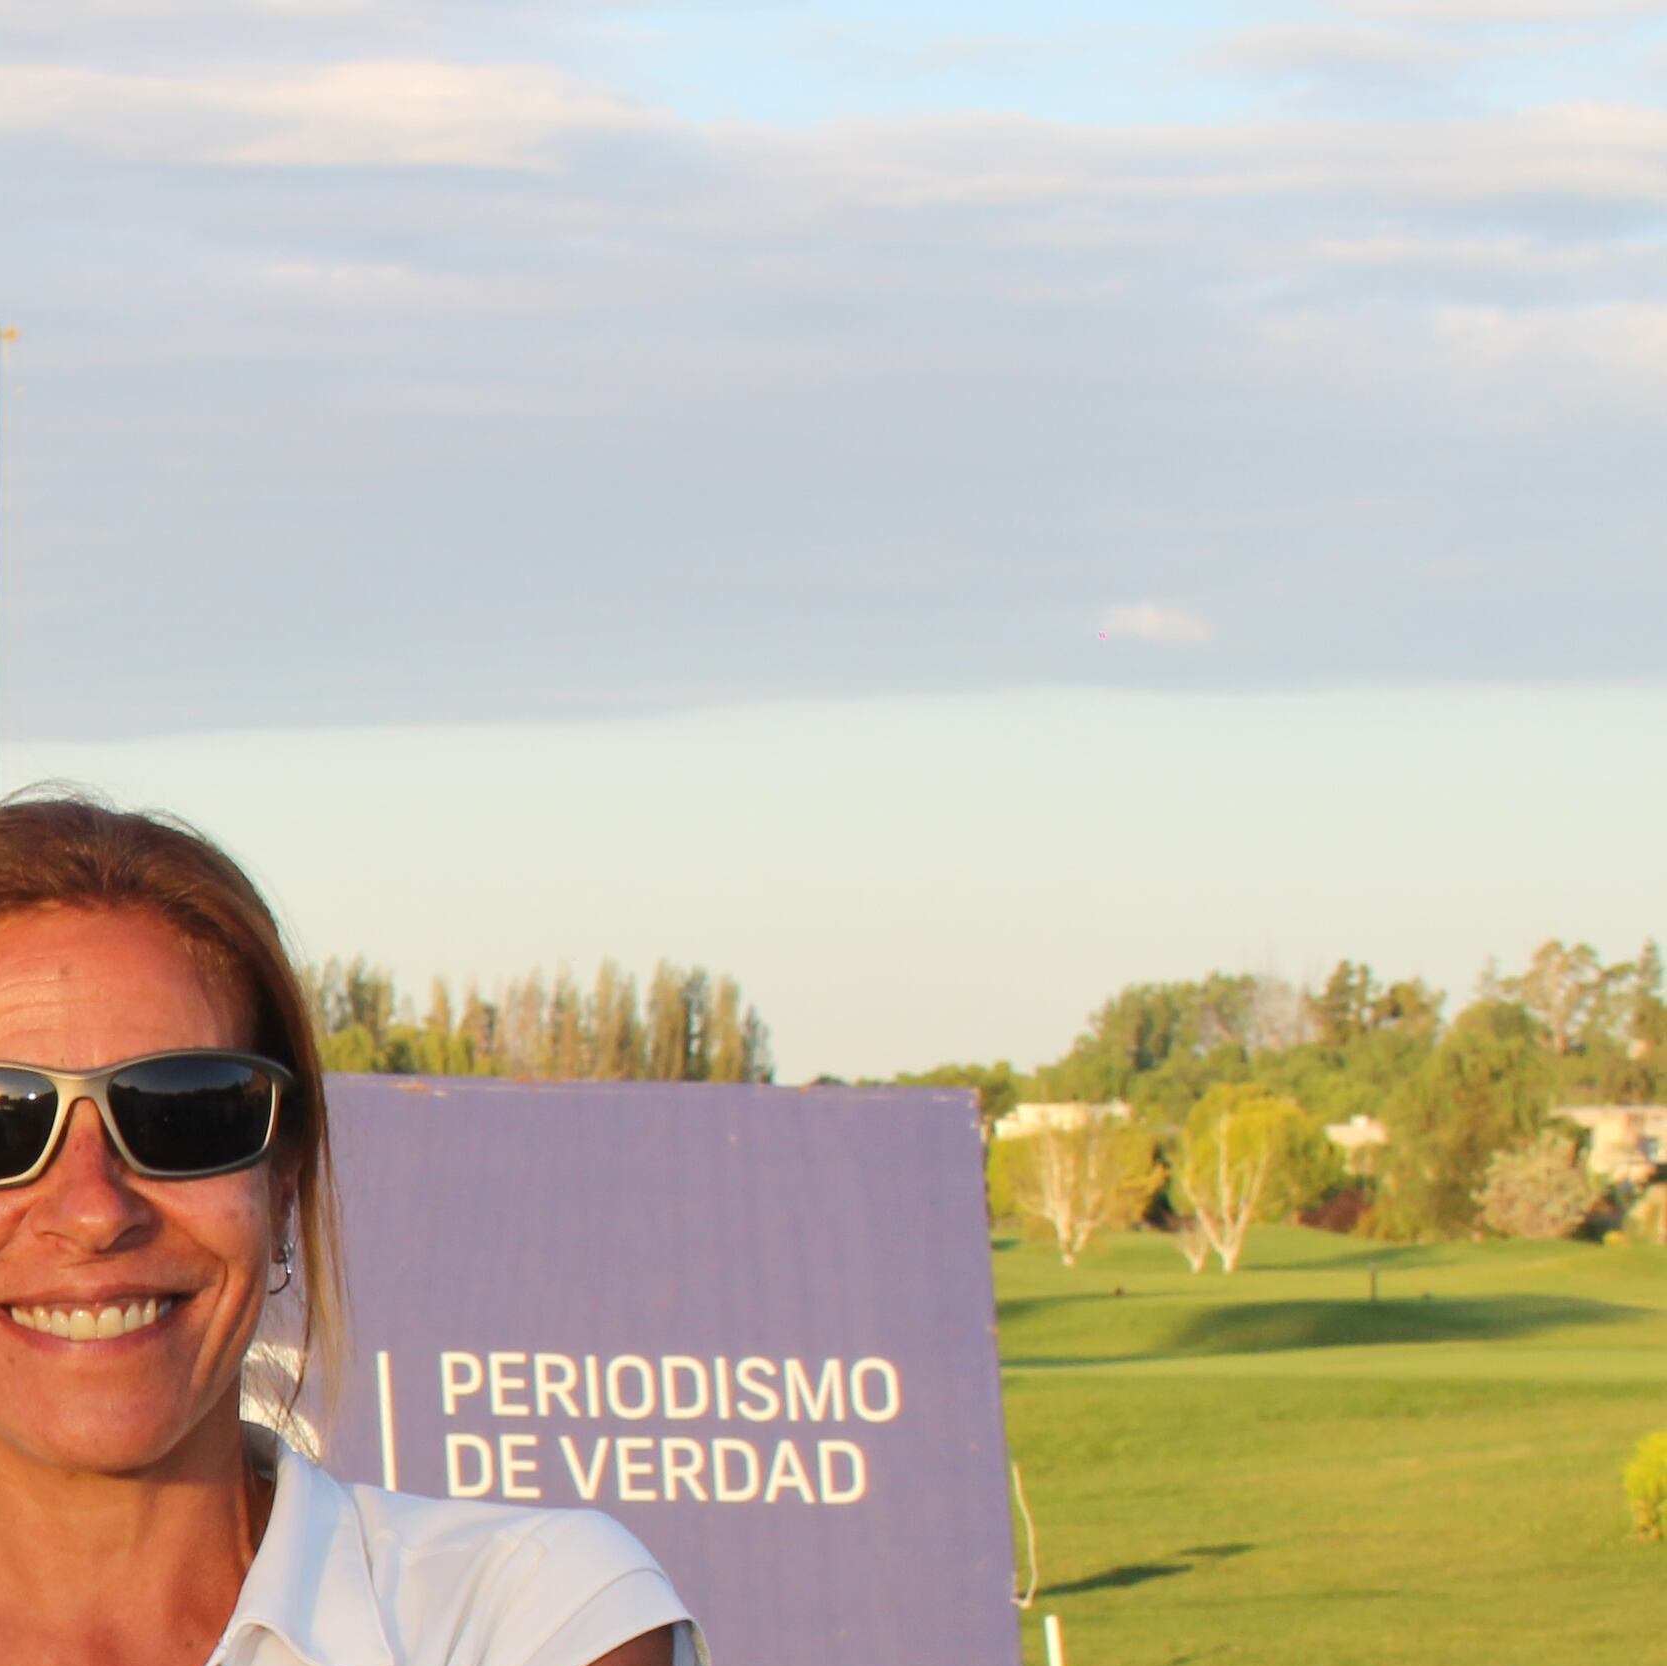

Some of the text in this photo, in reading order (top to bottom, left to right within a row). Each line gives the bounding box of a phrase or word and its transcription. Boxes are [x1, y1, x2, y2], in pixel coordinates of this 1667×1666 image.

[440, 1351, 902, 1424] PERIODISMO
[445, 1433, 869, 1504] DE VERDAD
